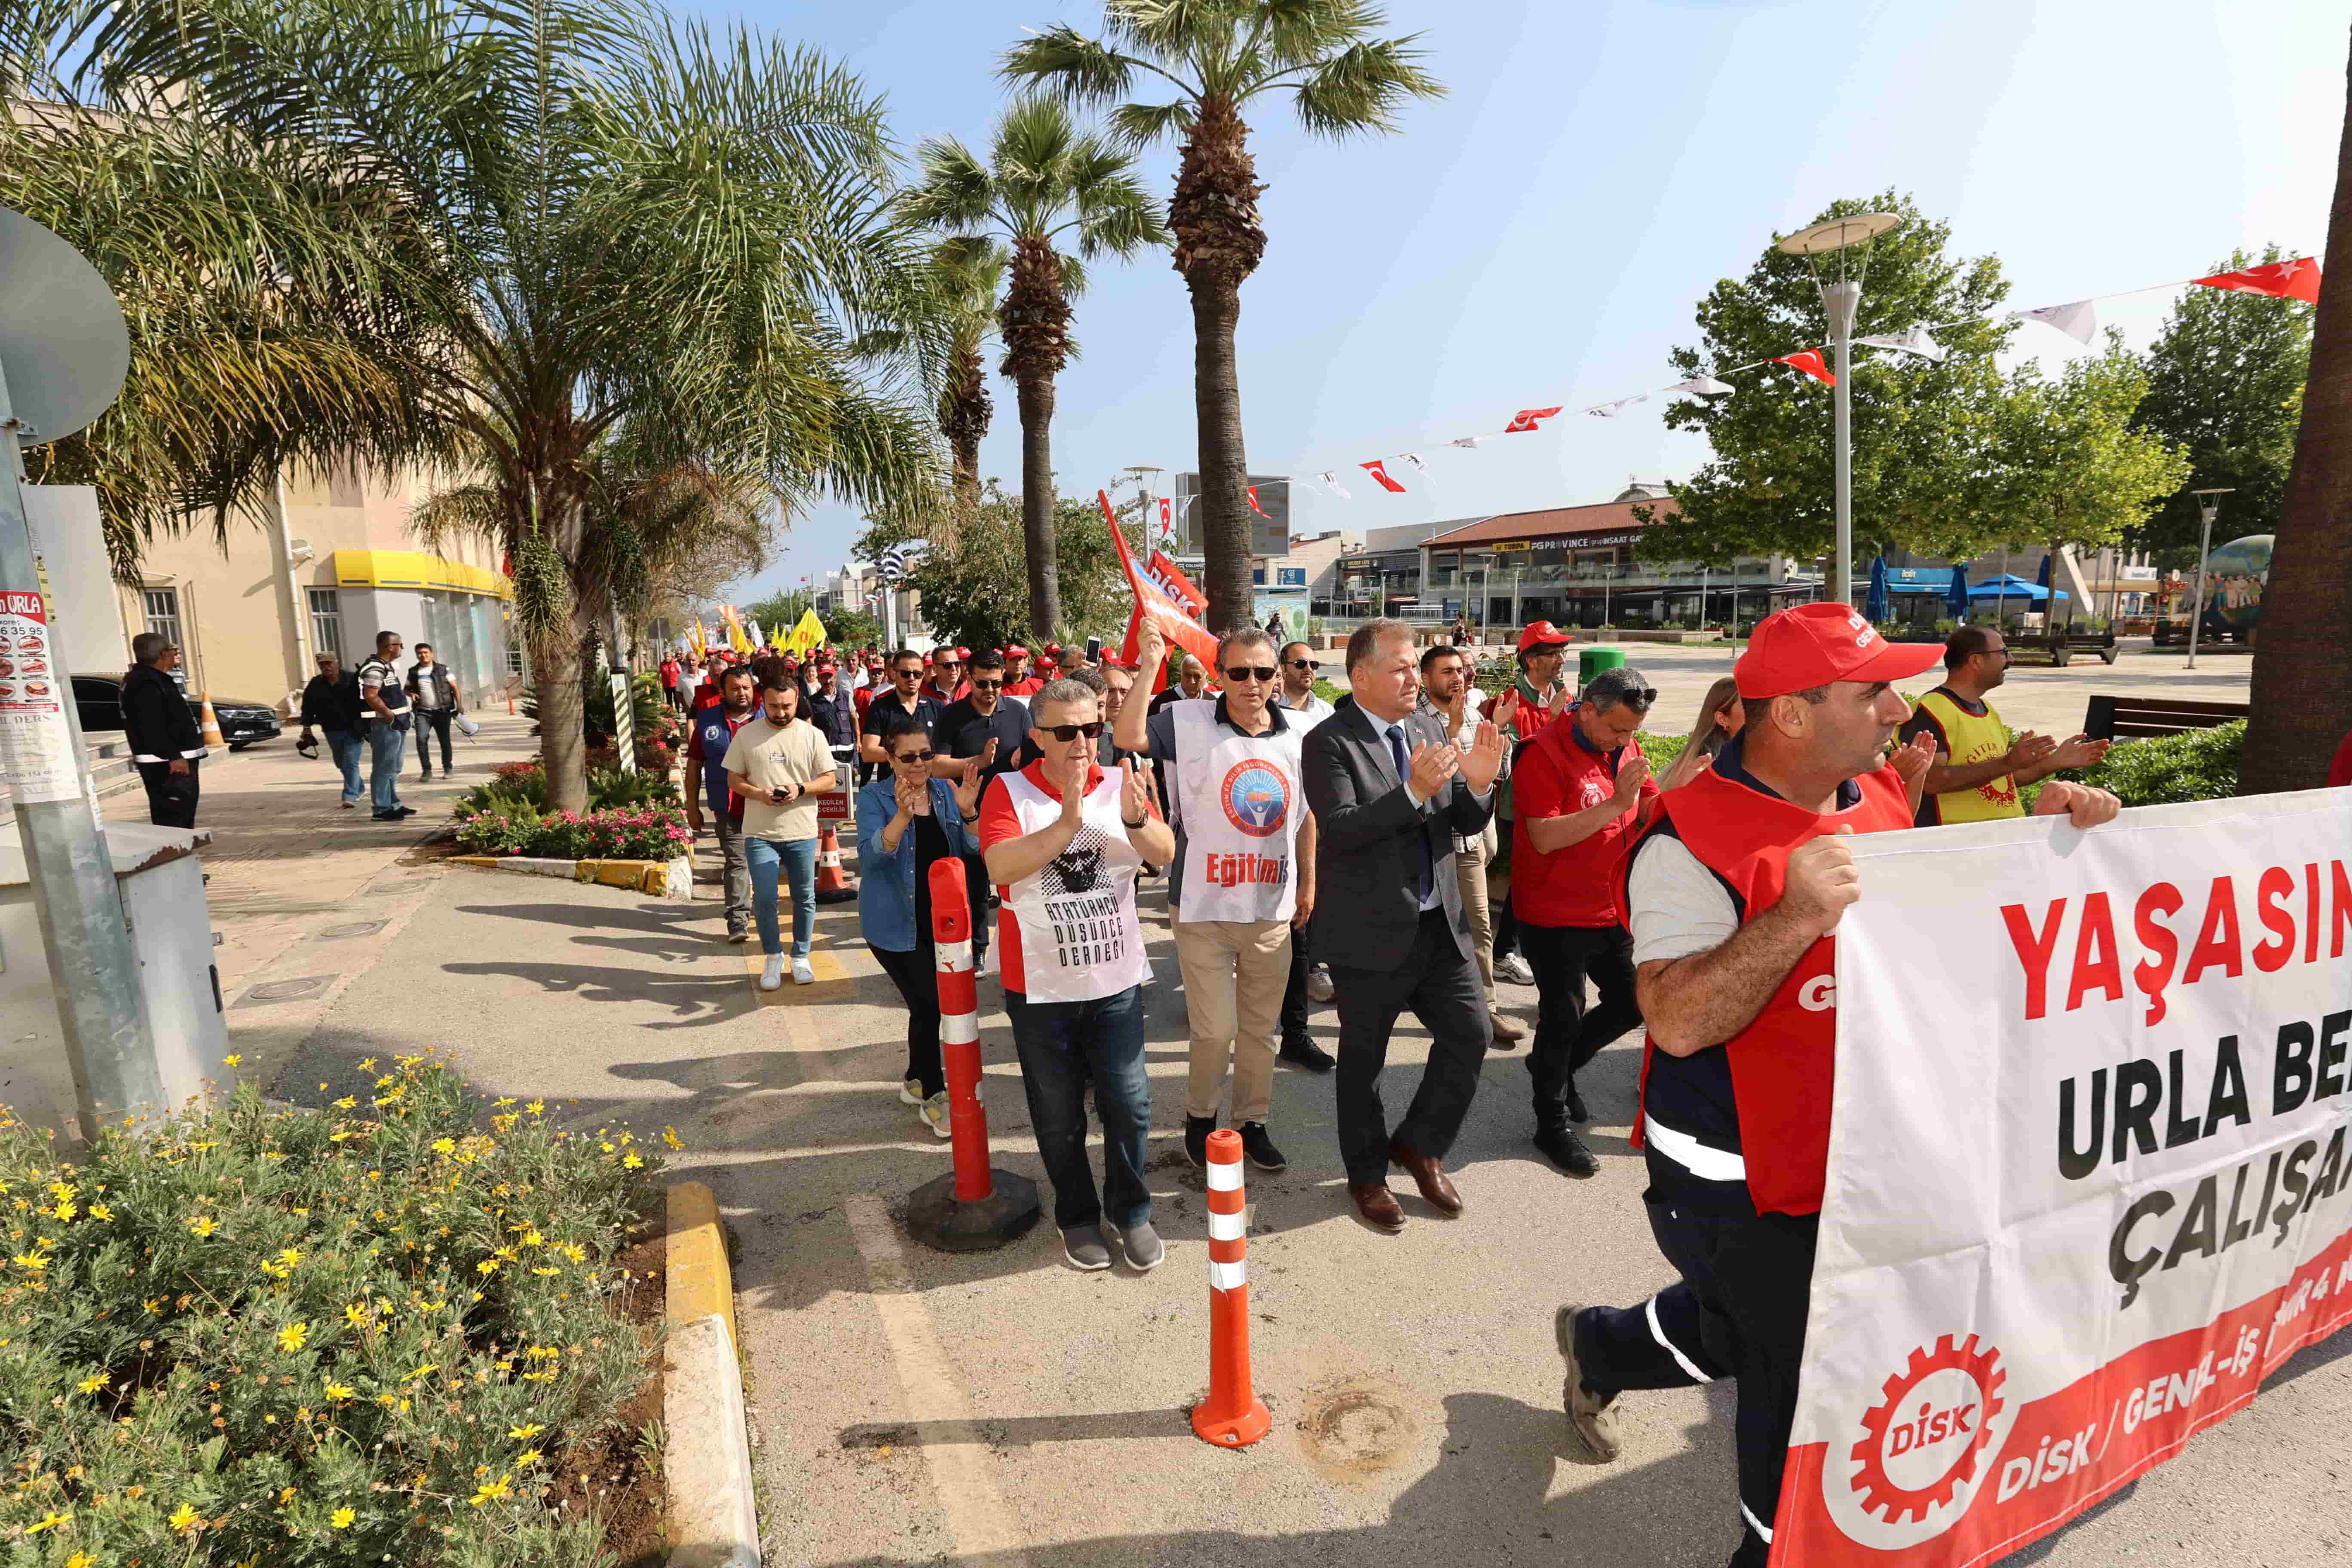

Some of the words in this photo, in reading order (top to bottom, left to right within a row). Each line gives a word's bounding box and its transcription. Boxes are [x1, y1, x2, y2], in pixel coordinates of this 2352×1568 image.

[7, 595, 41, 614] URLA
[11, 627, 25, 635] 35
[28, 627, 43, 635] 95
[1044, 893, 1119, 921] ATATÜRKÇÜ
[1054, 917, 1123, 944] DÜŞÜNCE
[1059, 936, 1124, 967] DERNEĞİ
[2058, 1035, 2251, 1180] URLA
[2272, 1009, 2352, 1117] BE
[2109, 1125, 2352, 1311] ÇALIŞA
[1888, 1402, 1976, 1458] DİSK
[1996, 1422, 2097, 1505] DİSK
